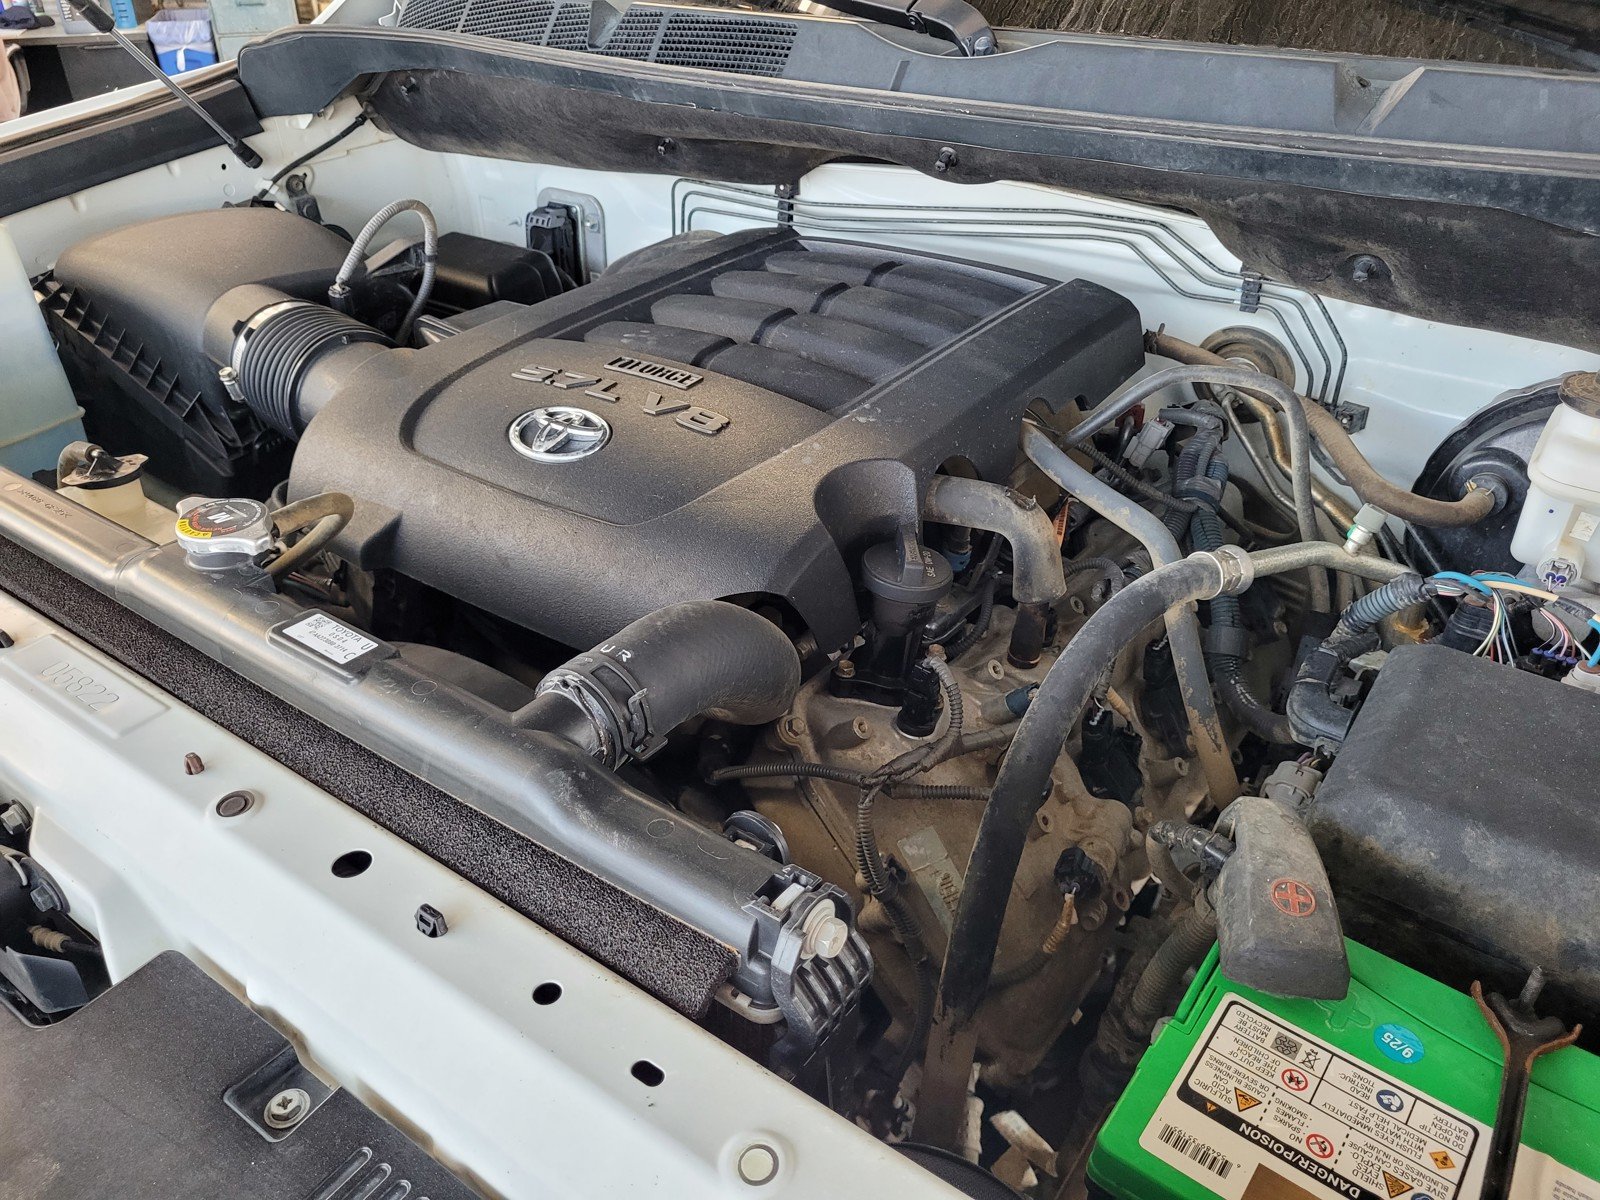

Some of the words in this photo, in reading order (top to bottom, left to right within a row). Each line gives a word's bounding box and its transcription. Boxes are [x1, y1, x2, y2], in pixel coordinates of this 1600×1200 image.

[511, 366, 620, 402] 5.7L
[643, 391, 730, 434] V8
[926, 566, 936, 578] SAE
[332, 624, 362, 642] TOYOTA
[1234, 1008, 1271, 1031] RECYCLED.
[1237, 1017, 1247, 1026] BE
[1233, 1023, 1265, 1043] BATTERY
[1247, 1023, 1268, 1037] MUST
[1227, 1048, 1238, 1058] OF
[1231, 1036, 1270, 1060] CHILDREN.
[1381, 1032, 1414, 1058] 9/25
[1206, 1053, 1232, 1071] BURNS.
[1236, 1046, 1261, 1063] REACH
[1238, 1054, 1254, 1067] OUT
[1269, 1056, 1281, 1066] OF
[1204, 1059, 1242, 1085] BLINDNESS
[1255, 1064, 1275, 1078] KEEP
[1261, 1060, 1277, 1072] THE
[1212, 1072, 1228, 1085] CAN
[1232, 1067, 1259, 1086] SEVERE
[1337, 1071, 1373, 1094] INSTRUC-
[1350, 1070, 1375, 1087] TIONS.
[1192, 1077, 1233, 1104] SULFURIC
[1210, 1079, 1231, 1094] ACID
[1242, 1081, 1266, 1098] CAUSE
[1258, 1082, 1269, 1092] OR
[1349, 1085, 1370, 1100] READ
[1273, 1096, 1308, 1119] SMOKING
[1347, 1098, 1368, 1114] FAST.
[1272, 1113, 1301, 1134] SPARKS
[1274, 1106, 1304, 1126] FLAMES
[1321, 1100, 1373, 1133] IMMEDIATELY
[1355, 1111, 1371, 1123] GET
[1368, 1110, 1390, 1125] HELP
[1431, 1112, 1468, 1137] BATTERY.
[1172, 1125, 1198, 1144] 35195
[1372, 1120, 1402, 1140] WATER.
[1391, 1122, 1427, 1146] MEDICAL
[1418, 1121, 1432, 1133] TIP
[1430, 1120, 1453, 1136] OPEN
[1288, 1132, 1302, 1144] NO
[1374, 1129, 1394, 1144] EYES
[1402, 1136, 1424, 1152] WITH
[1433, 1129, 1450, 1143] NOT
[1451, 1139, 1464, 1150] DO
[1454, 1132, 1466, 1143] OR
[1200, 1142, 1226, 1161] 56489
[1347, 1140, 1374, 1159] CAUSE
[1362, 1140, 1391, 1160] INJURY.
[1395, 1140, 1422, 1159] FLUSH
[1238, 1121, 1361, 1198] DANGER/POISON
[1348, 1149, 1381, 1172] EXPLO-
[1374, 1155, 1392, 1169] CAN
[1392, 1156, 1404, 1167] OR
[1351, 1167, 1385, 1191] SHIELD
[1392, 1165, 1424, 1187] GASES
[1404, 1163, 1449, 1192] BLINDNESS
[1424, 1183, 1446, 1200] SIVE
